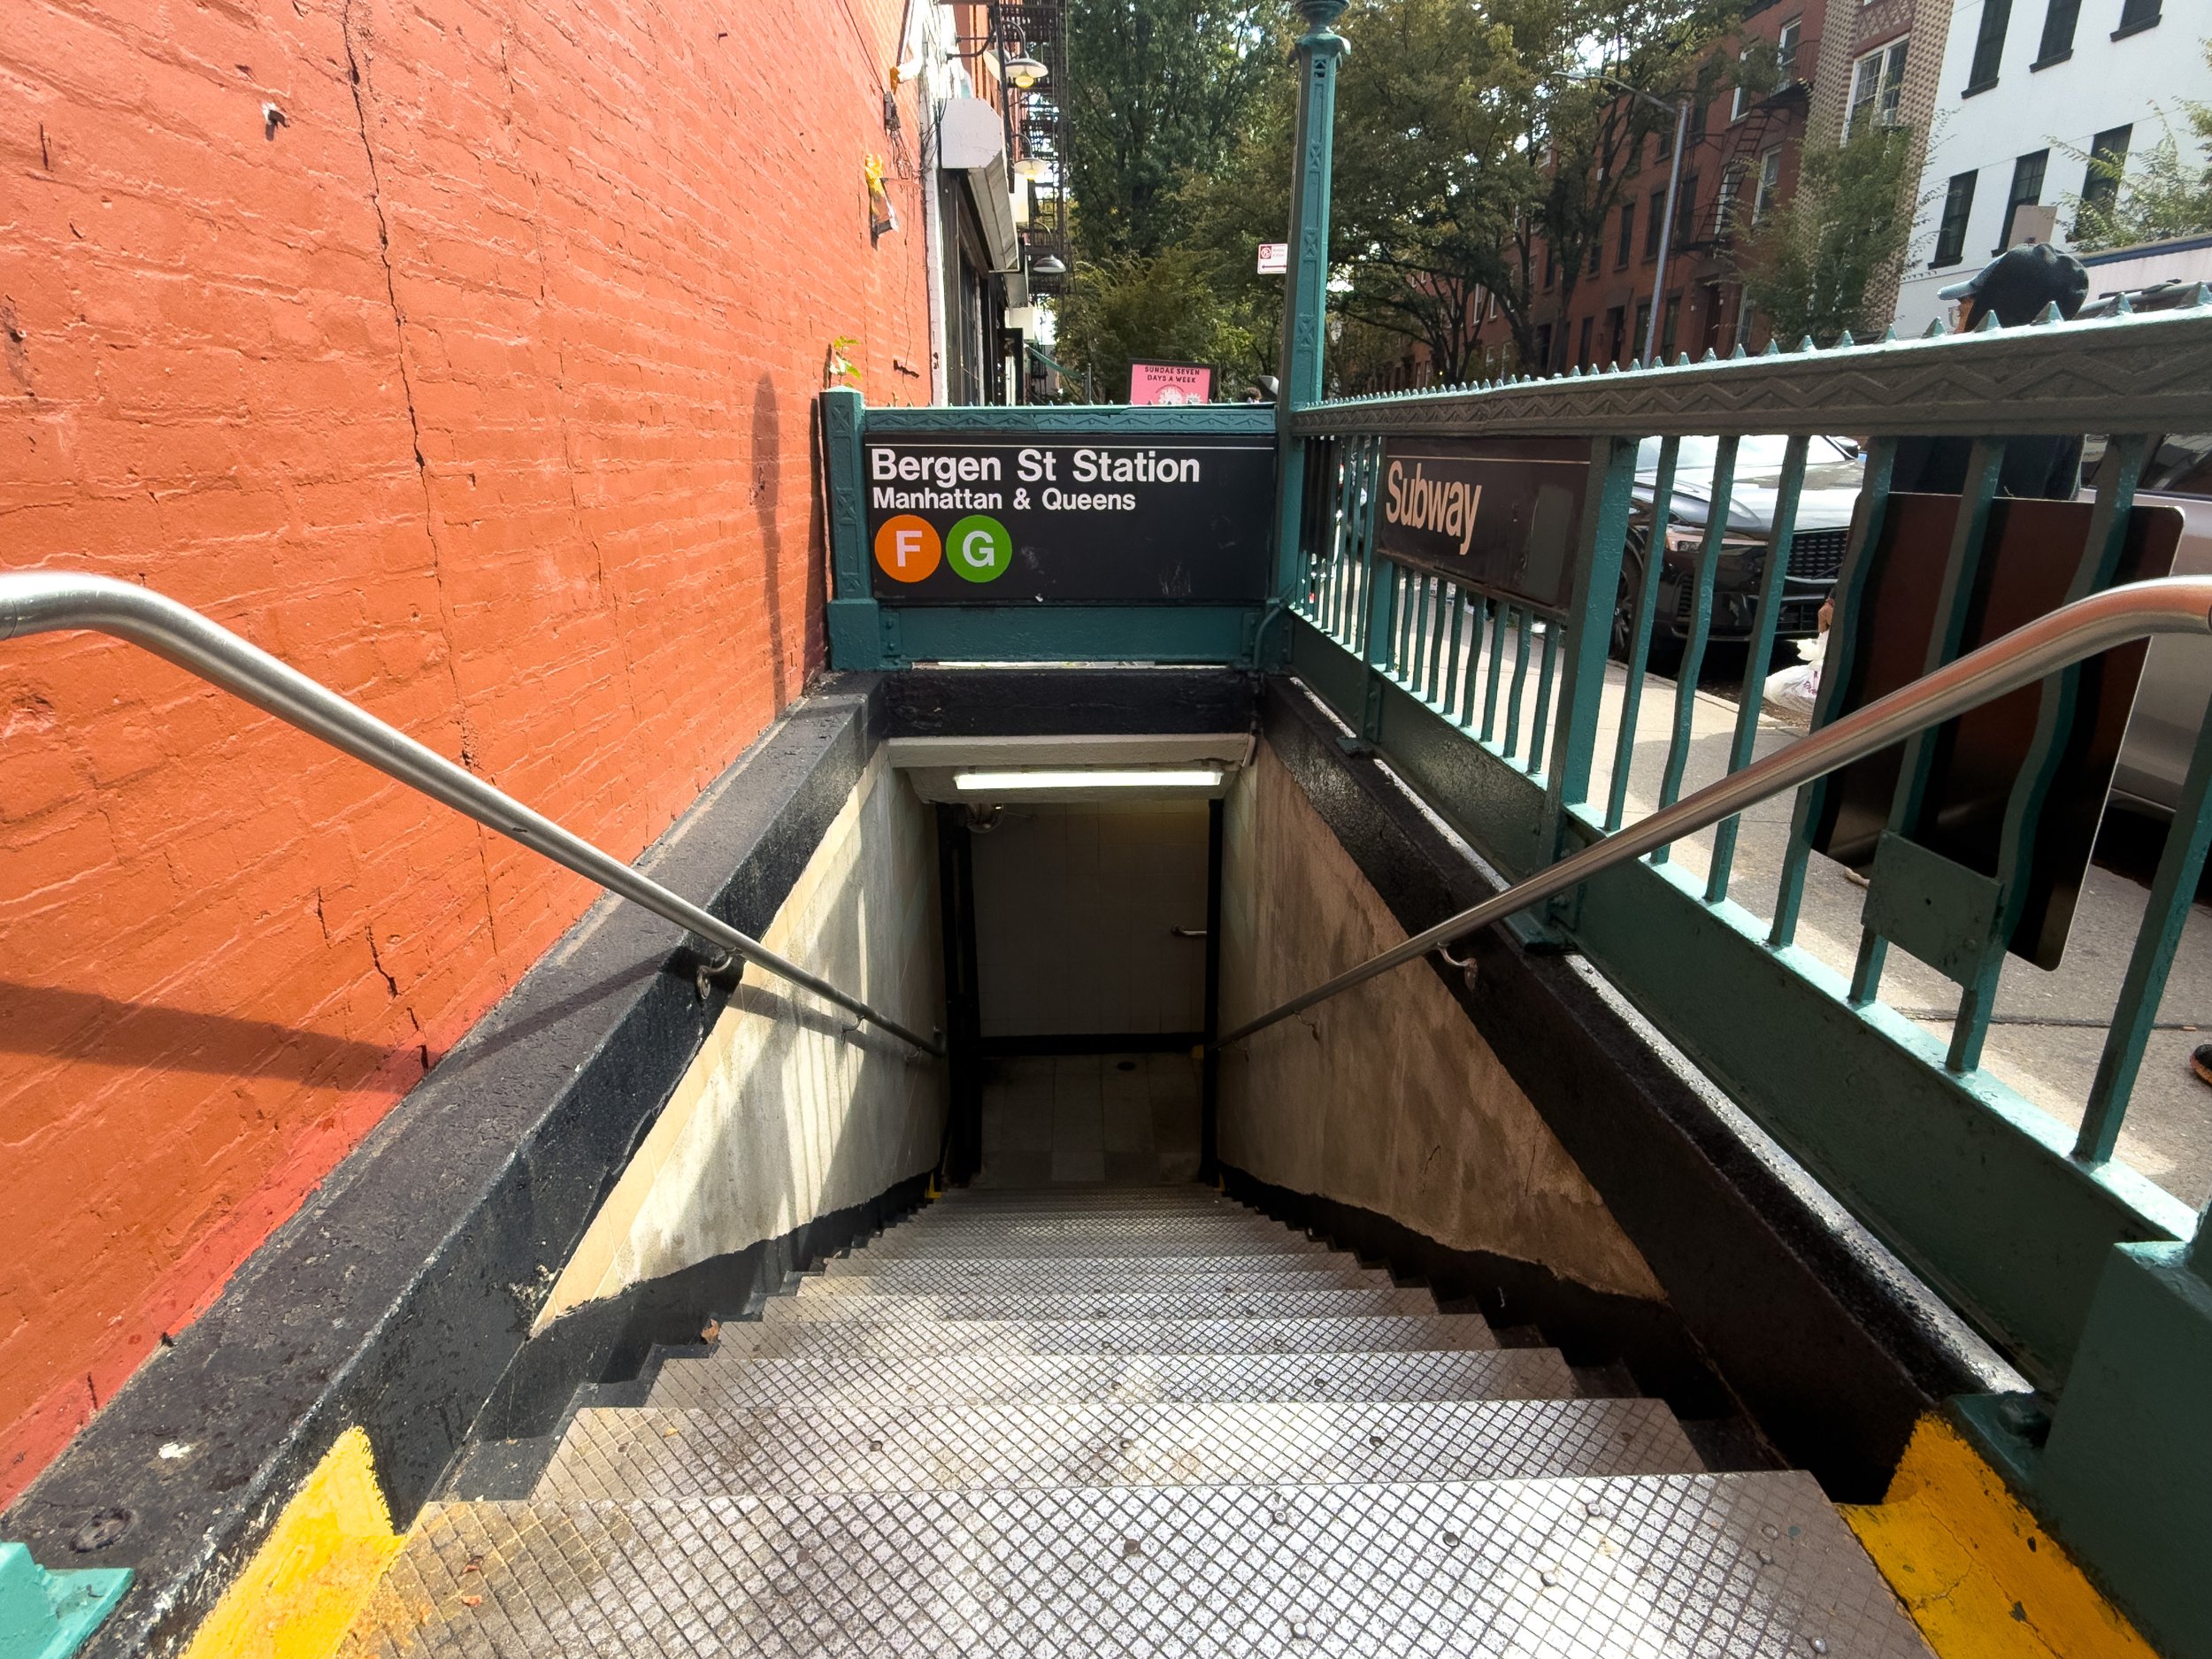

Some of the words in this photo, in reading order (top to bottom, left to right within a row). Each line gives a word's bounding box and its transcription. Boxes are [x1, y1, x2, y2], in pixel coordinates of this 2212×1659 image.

[872, 449, 1002, 488] Bergen
[1017, 449, 1056, 482] St
[1072, 449, 1200, 483] Station
[872, 487, 1002, 510] Manhattan
[1013, 488, 1032, 511] &
[1041, 488, 1136, 511] Queens
[1386, 459, 1483, 556] Subway
[896, 531, 923, 567] F
[962, 531, 995, 567] G
